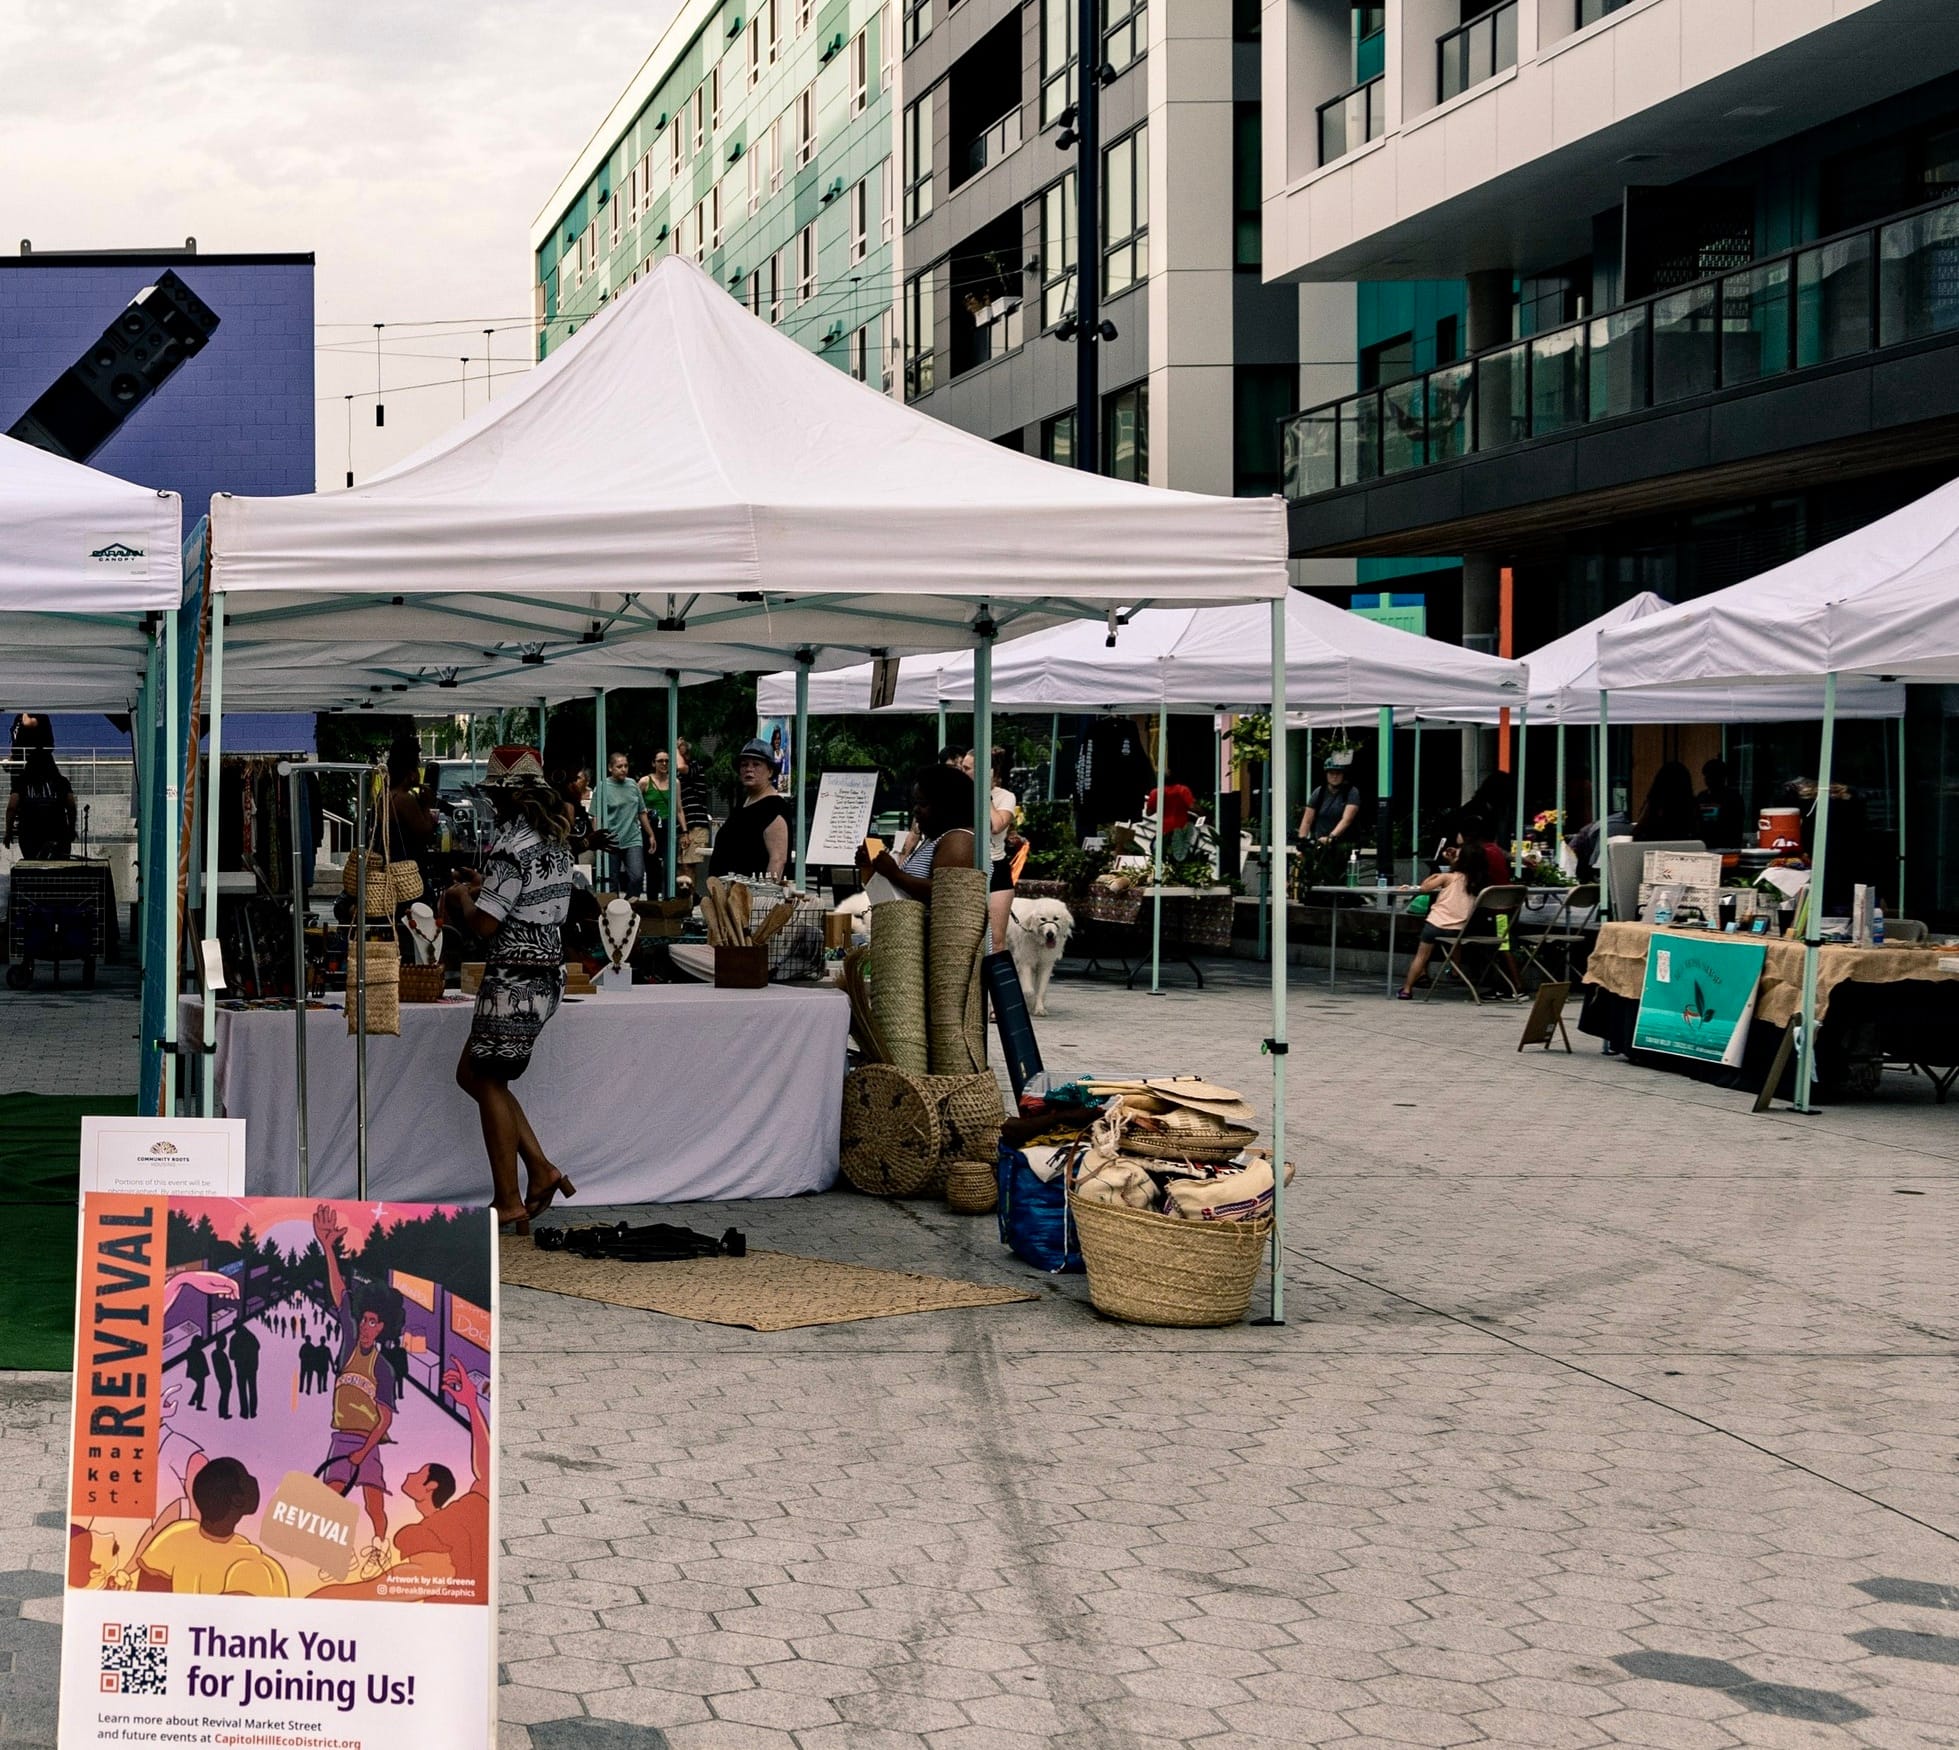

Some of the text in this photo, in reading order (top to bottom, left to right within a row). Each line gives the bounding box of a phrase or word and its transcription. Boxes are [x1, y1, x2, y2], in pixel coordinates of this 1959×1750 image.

[114, 1178, 143, 1186] Portions
[145, 1178, 154, 1186] of
[189, 1179, 201, 1187] will
[90, 1207, 153, 1437] REVIVAL
[272, 1500, 350, 1546] REVIVAL
[386, 1575, 420, 1584] Artwork
[420, 1576, 431, 1586] by
[446, 1577, 476, 1586] Greene
[188, 1625, 357, 1663] Thank You
[187, 1665, 415, 1712] for Joining Us!
[97, 1712, 322, 1732] Learn more about Revival Market Street
[97, 1729, 361, 1750] and future events at CapitolHillEcoDistrict.org
